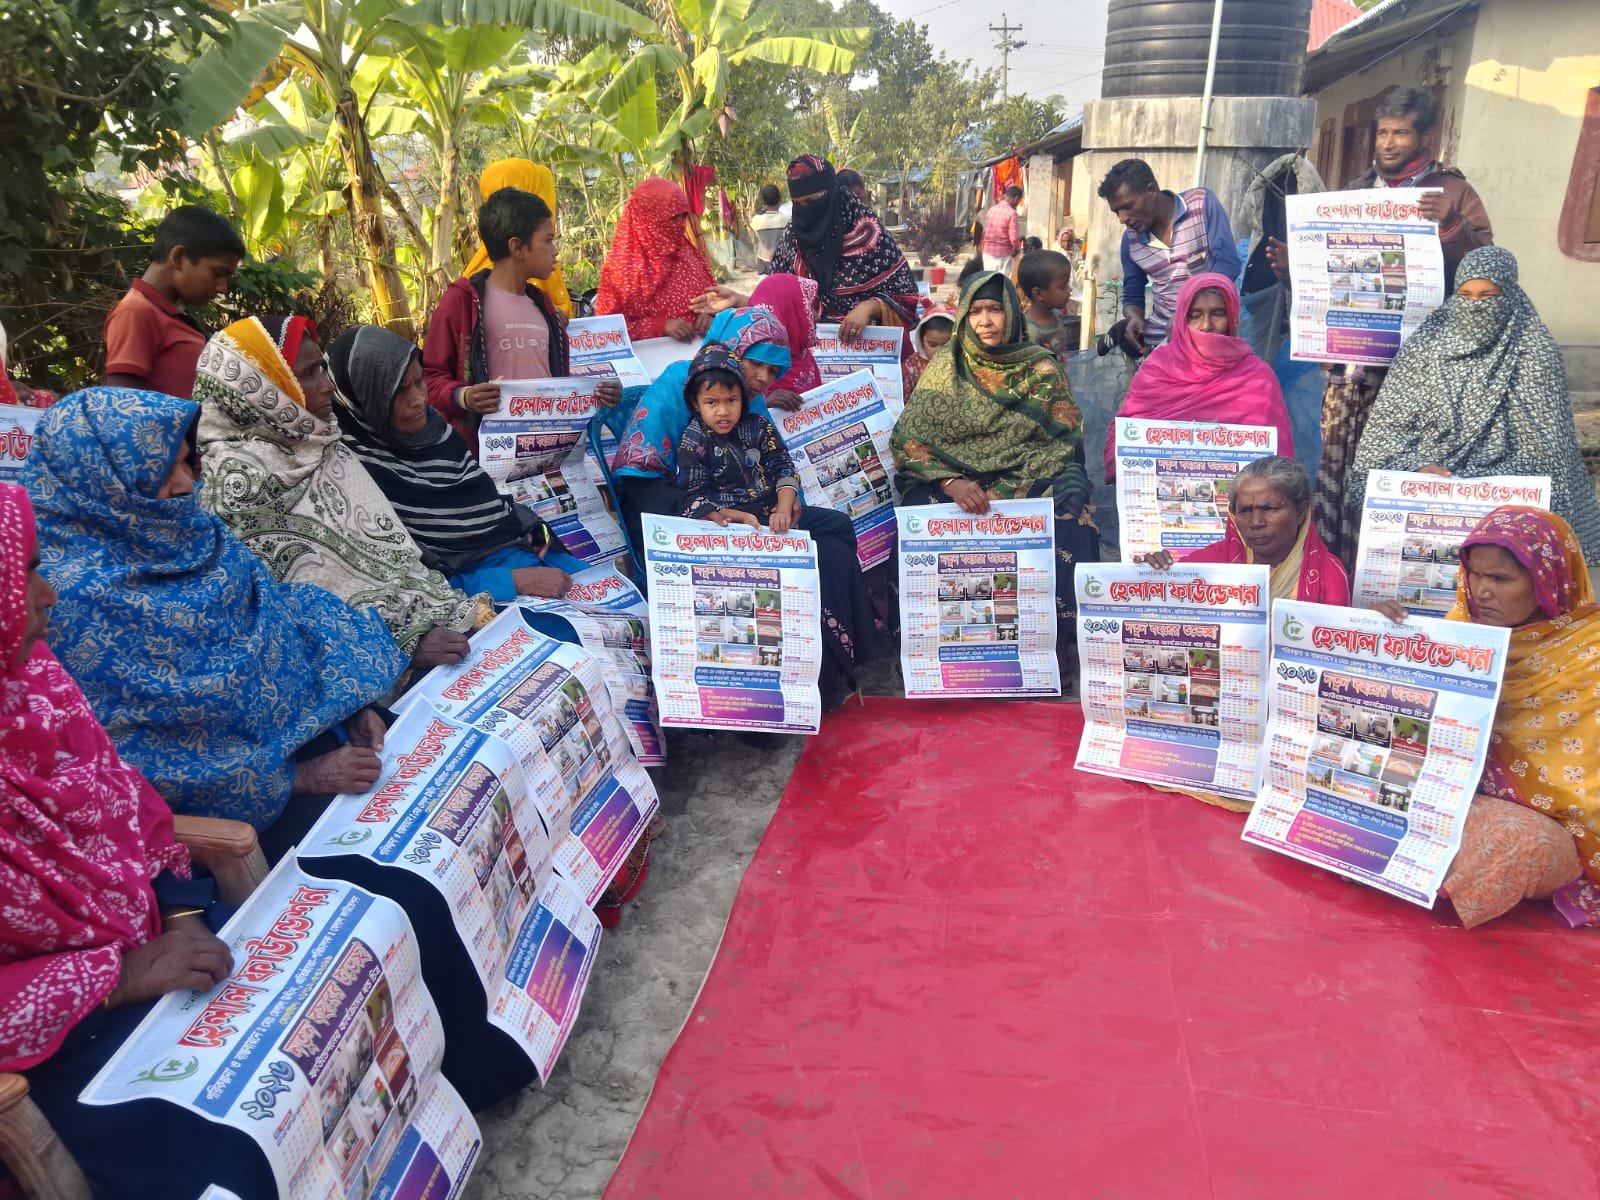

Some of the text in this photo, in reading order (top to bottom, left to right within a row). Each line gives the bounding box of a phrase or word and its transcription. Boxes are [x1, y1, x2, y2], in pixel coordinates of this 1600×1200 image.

[1317, 200, 1423, 221] হেলাল ফাউন্ডেশ
[509, 396, 555, 417] হেলাল
[783, 382, 877, 433] হেলাল ফাউন্ডেশন
[485, 435, 514, 451] ২০২৬
[1146, 425, 1270, 448] হেলাল ফাউন্ডেশন
[1122, 458, 1154, 468] ২০২৬
[1401, 480, 1542, 505] হেলাল ফাউন্ডেশন
[927, 513, 1047, 537] হেলাল ফাউন্ডেশন
[1369, 511, 1404, 523] ২০২৬
[676, 533, 810, 553] হেলাল ফাউন্ডেশন
[654, 563, 690, 577] ২০২৬
[905, 554, 937, 567] ২০২৬
[1109, 578, 1260, 606] হেলাল ফাউন্ডেশন
[1084, 619, 1120, 634] ২০২৬
[1312, 625, 1495, 675] হেলাল ফাউন্ডেশন
[441, 627, 541, 703] হেলাল ফাউন্ডেশন
[1276, 662, 1318, 684] ২০২৬
[354, 780, 417, 823] হেলাল
[390, 717, 463, 780] ফাউন্ডেশন
[404, 831, 442, 865] ২০২৬
[177, 885, 338, 1048] হেলাল ফাউন্ডেশন
[283, 1018, 322, 1059] নতুন
[305, 979, 347, 1026] বছরের
[332, 940, 374, 987] শুভেচ্ছা
[240, 1059, 296, 1122] ২০২৬
